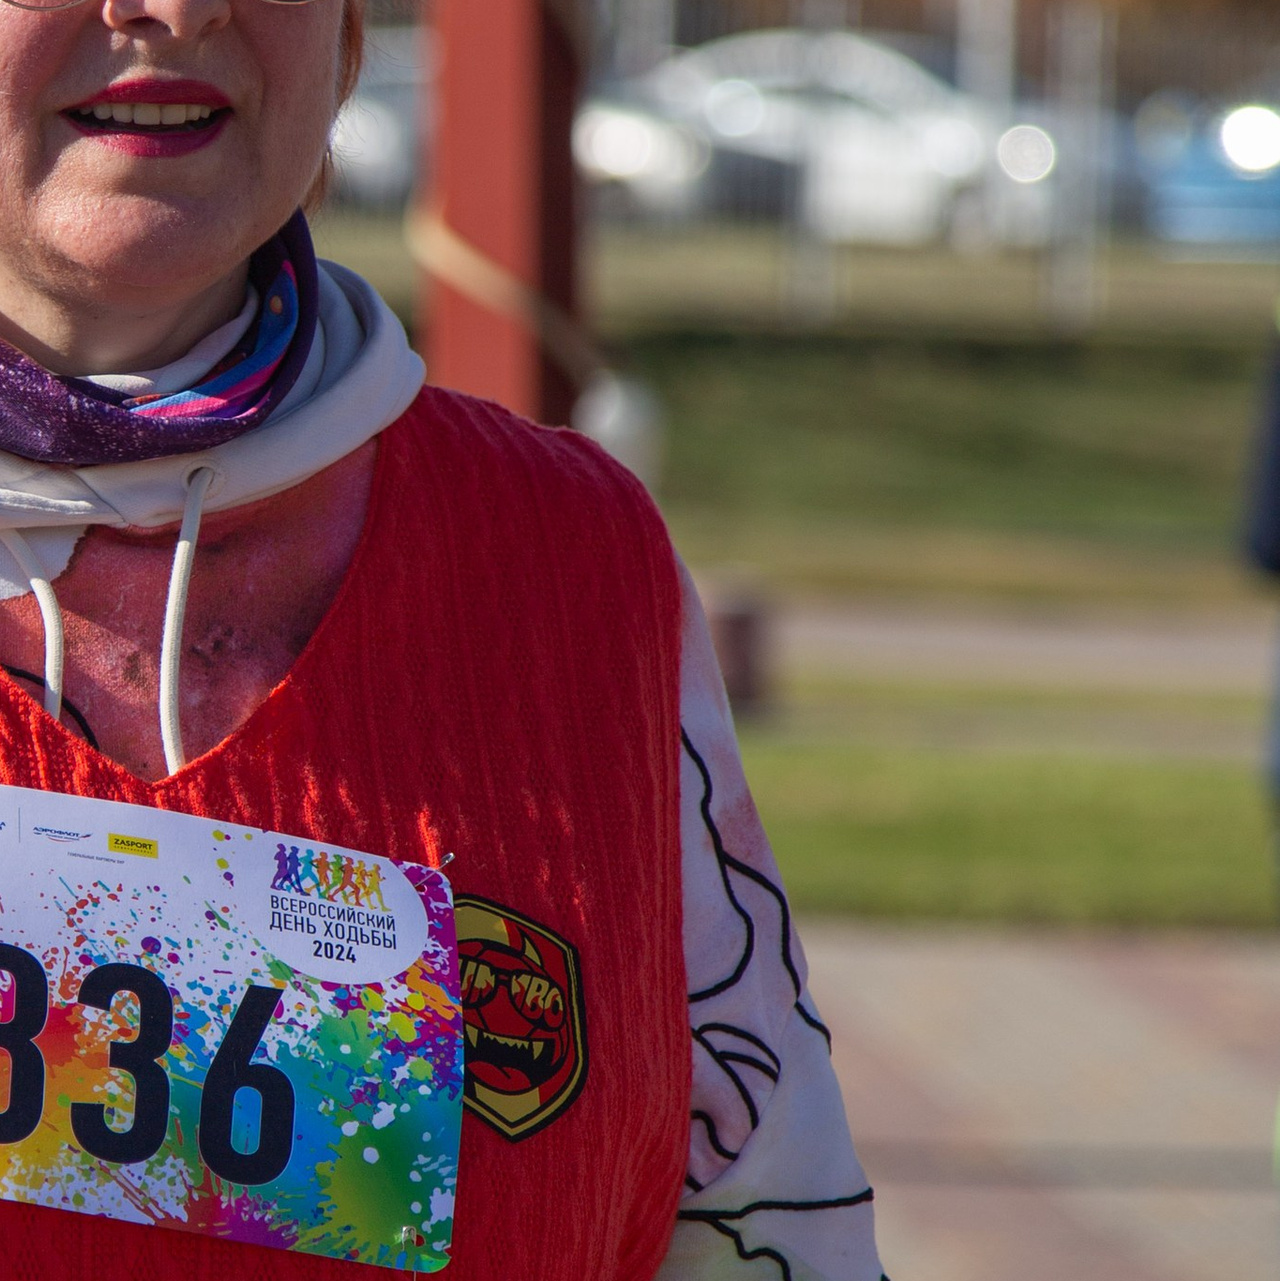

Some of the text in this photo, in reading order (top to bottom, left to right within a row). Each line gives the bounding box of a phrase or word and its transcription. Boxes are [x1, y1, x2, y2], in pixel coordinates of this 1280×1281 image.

[113, 838, 154, 851] ZASPORT
[270, 894, 396, 932] ВСЕРОССИЙСКИЙ
[269, 911, 397, 950] ДЕНЬ ХОДЬБЫ
[312, 939, 357, 964] 2024
